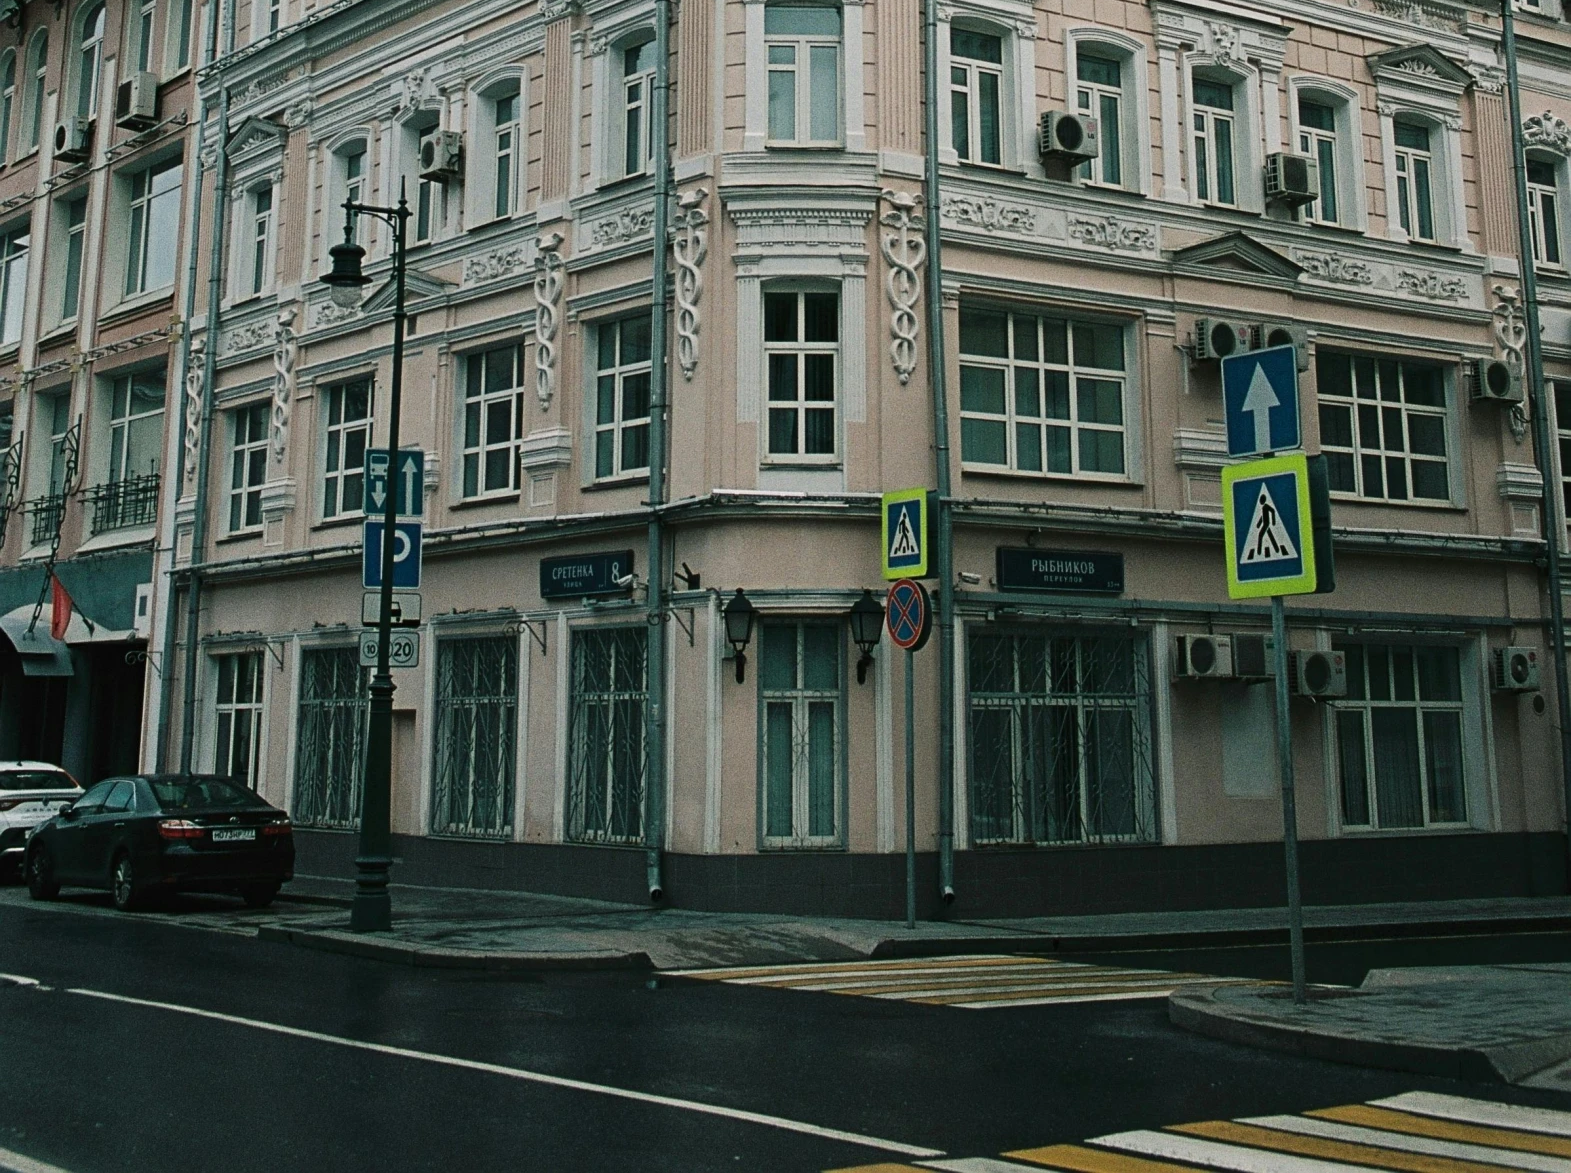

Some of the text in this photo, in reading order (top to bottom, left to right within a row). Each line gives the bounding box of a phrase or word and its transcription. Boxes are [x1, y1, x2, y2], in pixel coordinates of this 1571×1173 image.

[380, 529, 411, 580] P
[552, 561, 620, 584] СРЕТЕНКА 8
[1031, 559, 1095, 575] РЫБНИКОВ
[1043, 575, 1083, 583] ПЕРЕУЛОК
[366, 644, 376, 655] 10
[393, 642, 412, 657] 20
